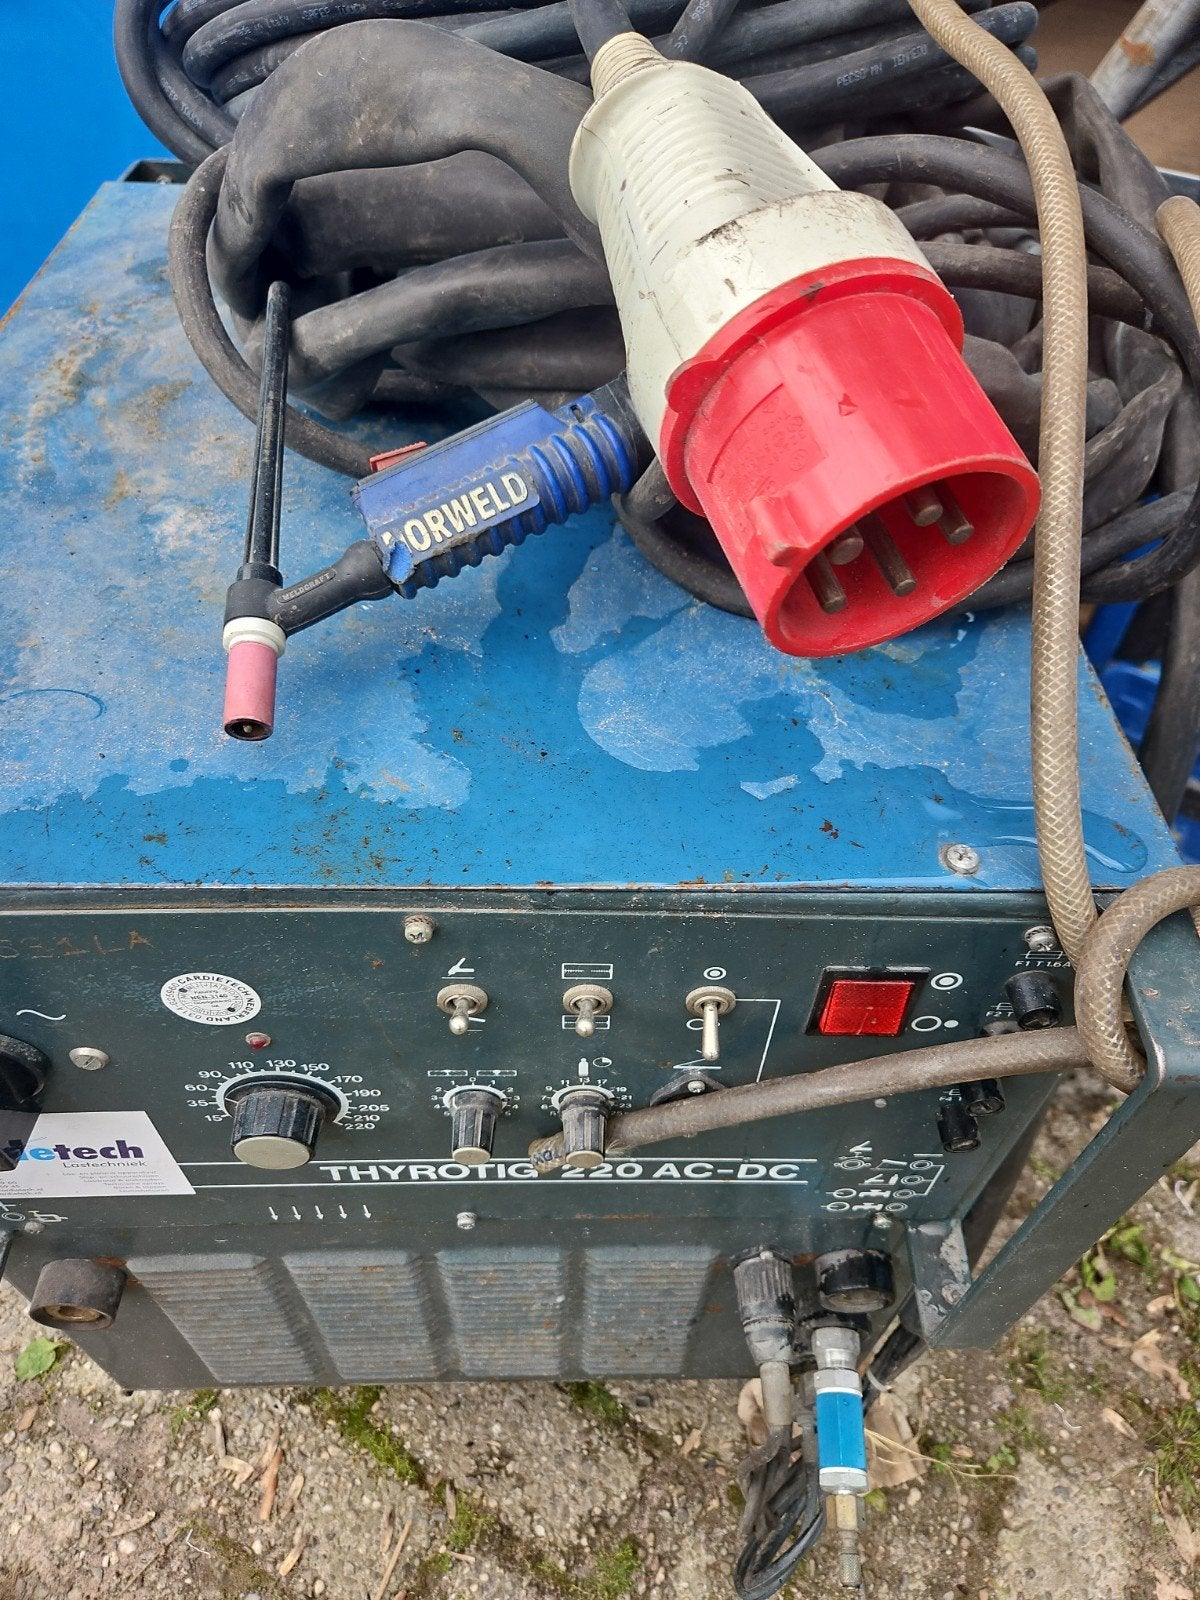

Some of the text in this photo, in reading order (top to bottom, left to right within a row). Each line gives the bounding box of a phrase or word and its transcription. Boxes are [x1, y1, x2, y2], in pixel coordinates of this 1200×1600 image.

[177, 975, 251, 996] CARDIETECH
[206, 997, 255, 1022] NEDERLAND
[228, 1061, 254, 1069] 110
[266, 1059, 297, 1068] 130
[300, 1063, 330, 1071] 150
[198, 1070, 222, 1078] 90
[334, 1075, 363, 1083] 170
[184, 1084, 208, 1092] 60
[352, 1089, 382, 1097] 190
[186, 1099, 208, 1107] 35
[204, 1114, 222, 1122] 15
[353, 1114, 381, 1122] 210
[344, 1122, 376, 1130] 220
[62, 1160, 148, 1169] Lastechniek
[319, 1163, 802, 1182] THYROTIG 220 AC-DC
